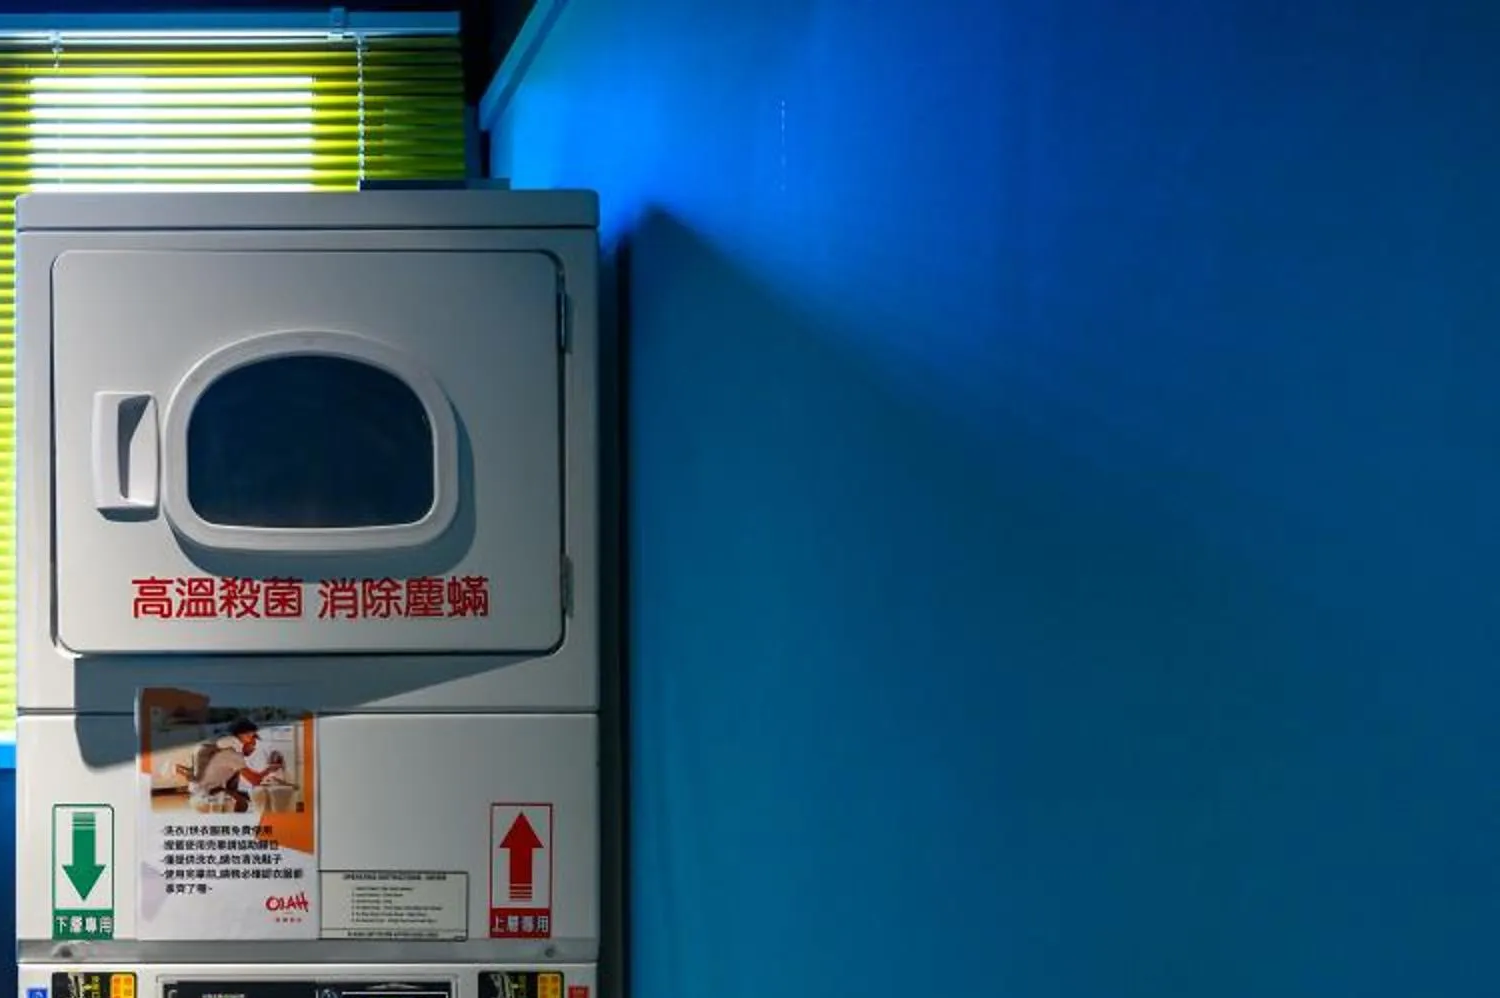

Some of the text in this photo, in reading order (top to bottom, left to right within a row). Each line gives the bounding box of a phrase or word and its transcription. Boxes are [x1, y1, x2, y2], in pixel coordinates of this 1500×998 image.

[131, 576, 489, 619] 高溫殺菌 消除塵蟎
[55, 915, 113, 936] 下層專用
[491, 914, 549, 934] 上層專用
